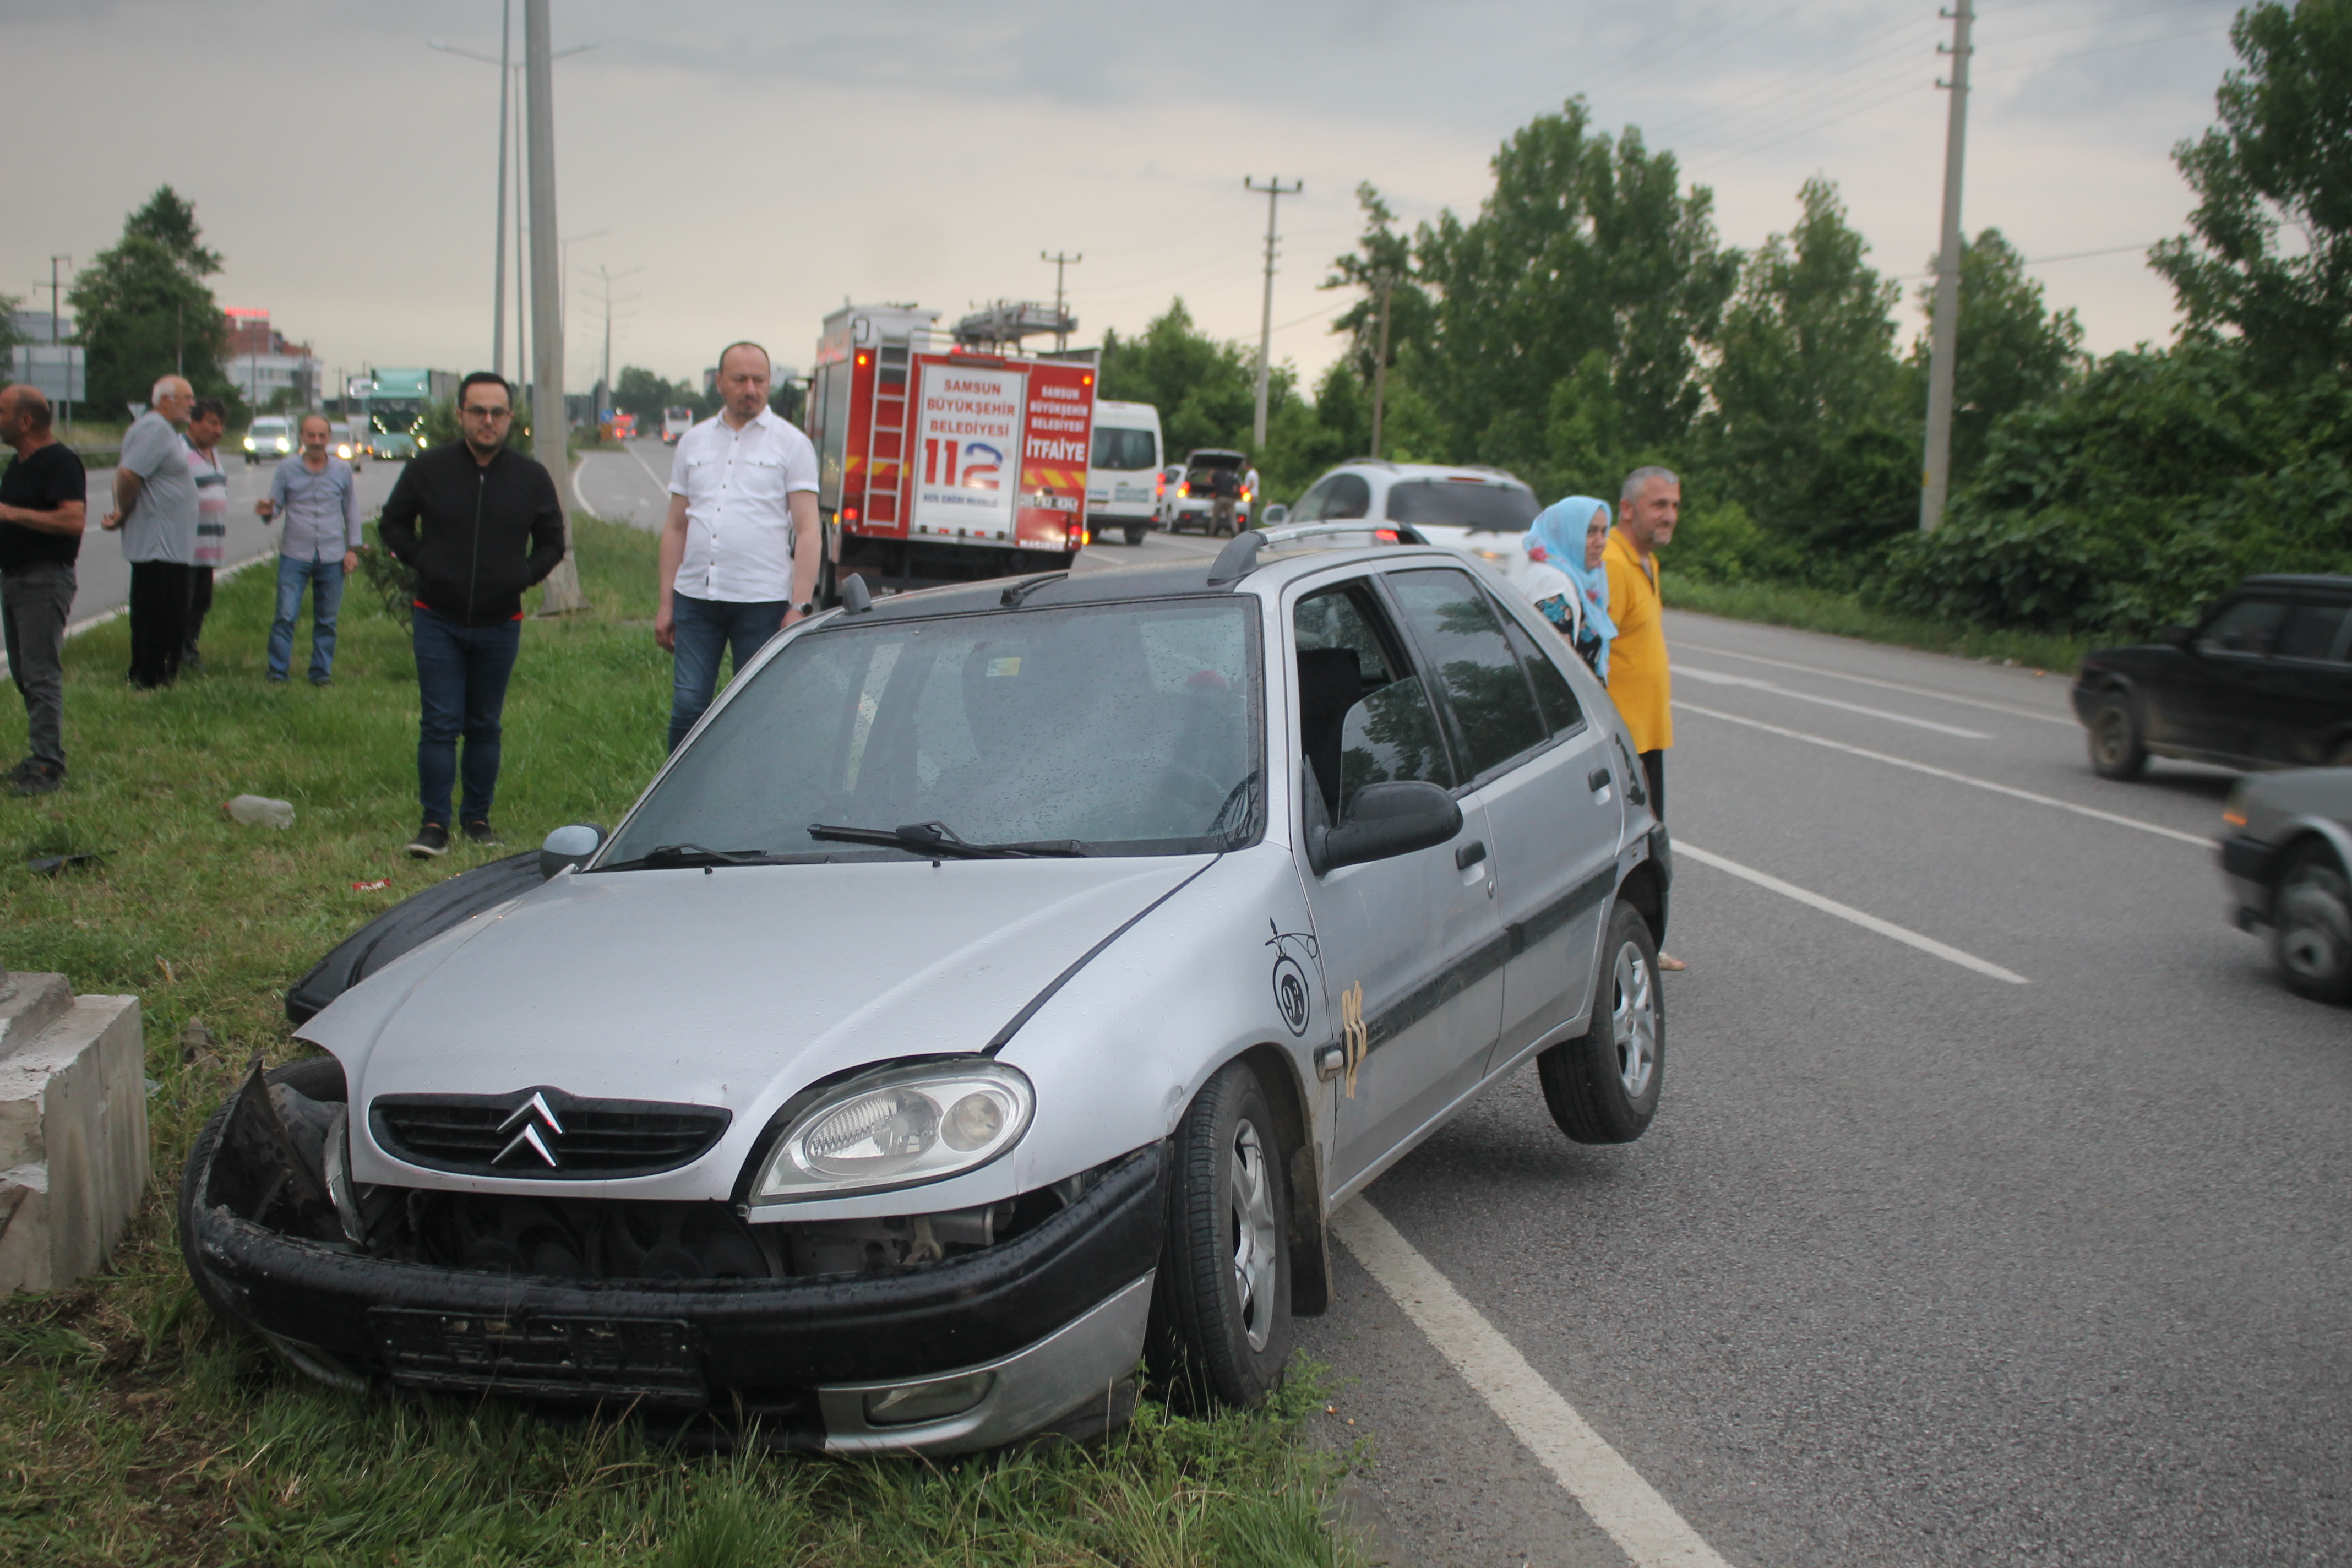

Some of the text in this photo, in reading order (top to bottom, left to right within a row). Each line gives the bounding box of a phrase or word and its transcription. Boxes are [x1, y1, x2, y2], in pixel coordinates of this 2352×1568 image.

[944, 379, 1001, 395] SAMSUN
[1041, 385, 1080, 400] SAMSUN
[927, 397, 1016, 417] BÜYÜKŞEHİR
[930, 418, 1009, 438] BELEDİYESİ
[1025, 434, 1086, 462] İTFAİYE
[925, 438, 1003, 490] 112
[1283, 986, 1295, 1018] 9
